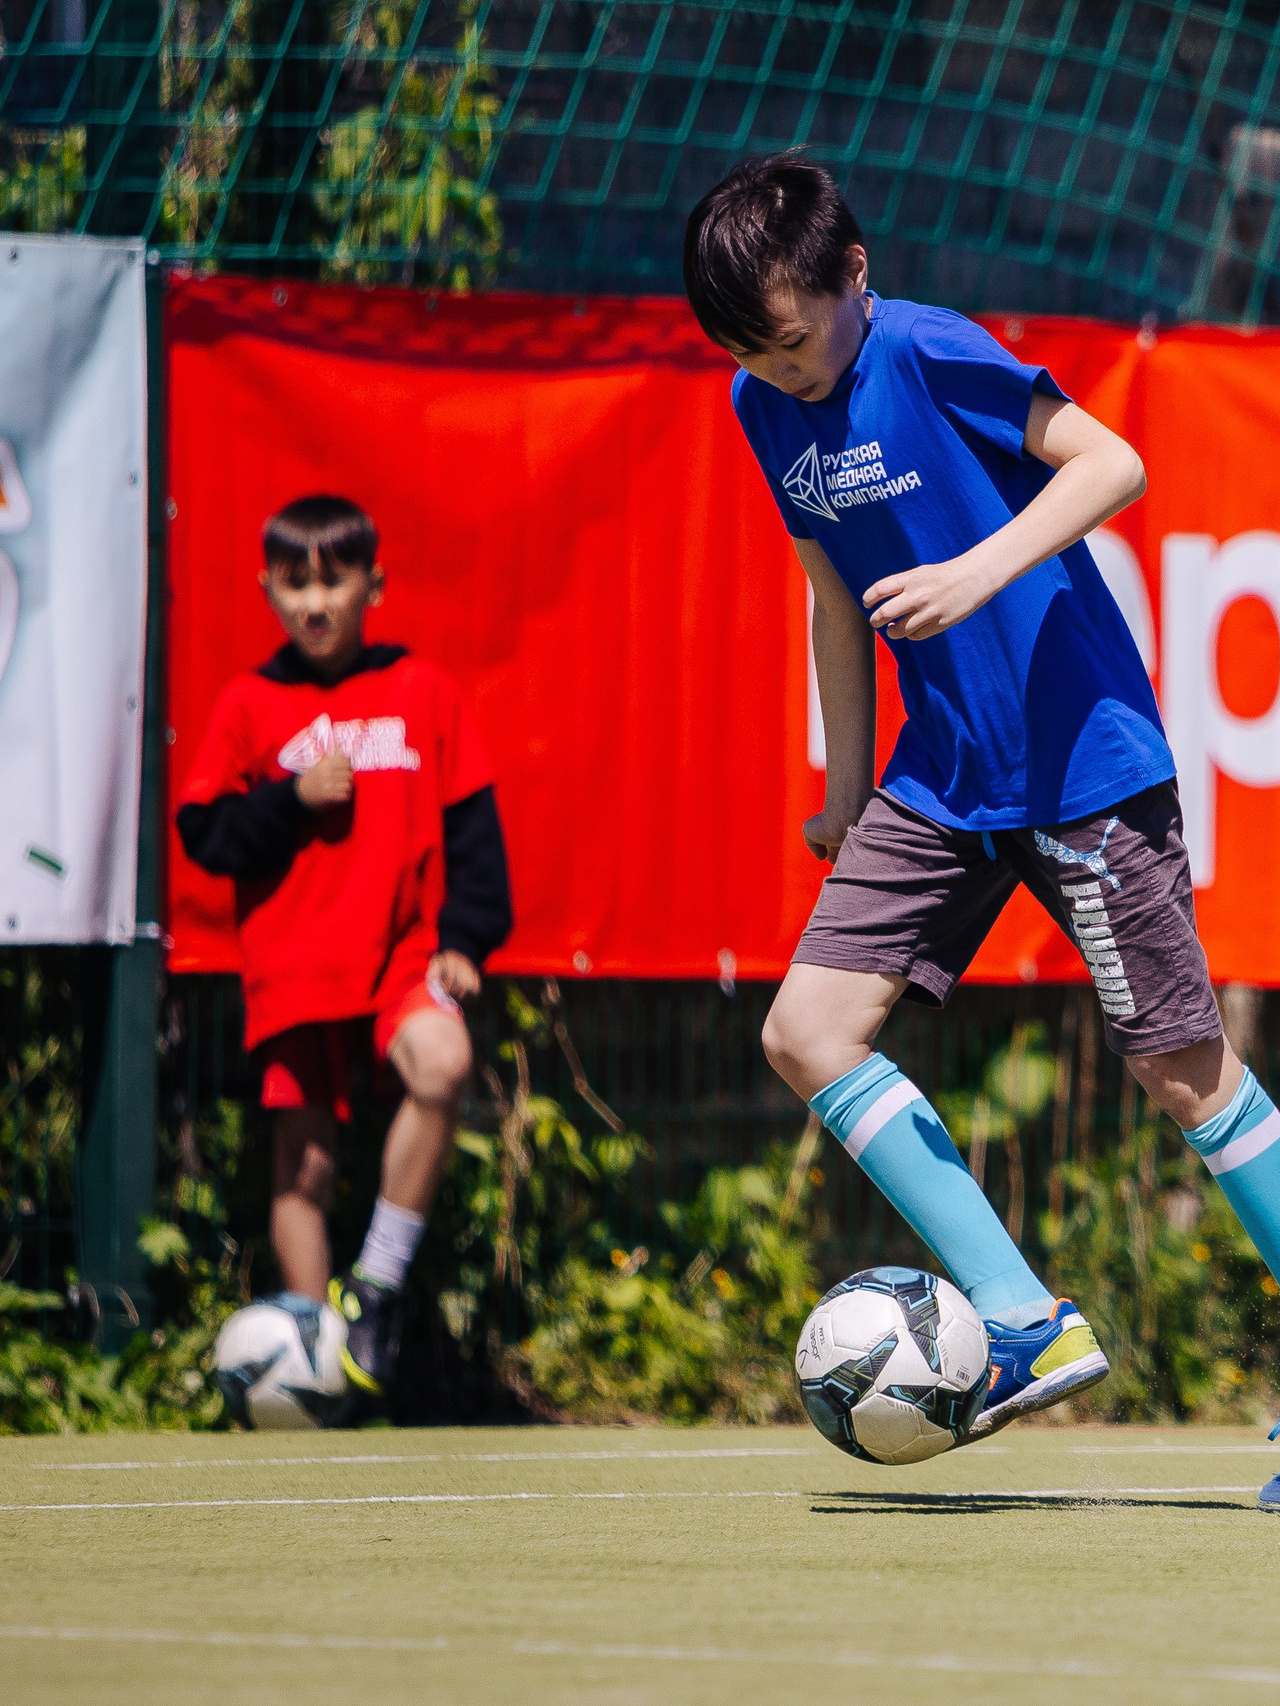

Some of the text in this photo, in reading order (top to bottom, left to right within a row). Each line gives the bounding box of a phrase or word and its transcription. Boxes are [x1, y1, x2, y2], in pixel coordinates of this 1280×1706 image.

[822, 440, 883, 471] РУССКАЯ
[825, 461, 887, 491] МЕДНАЯ
[829, 470, 922, 509] КОМПАНИЯ
